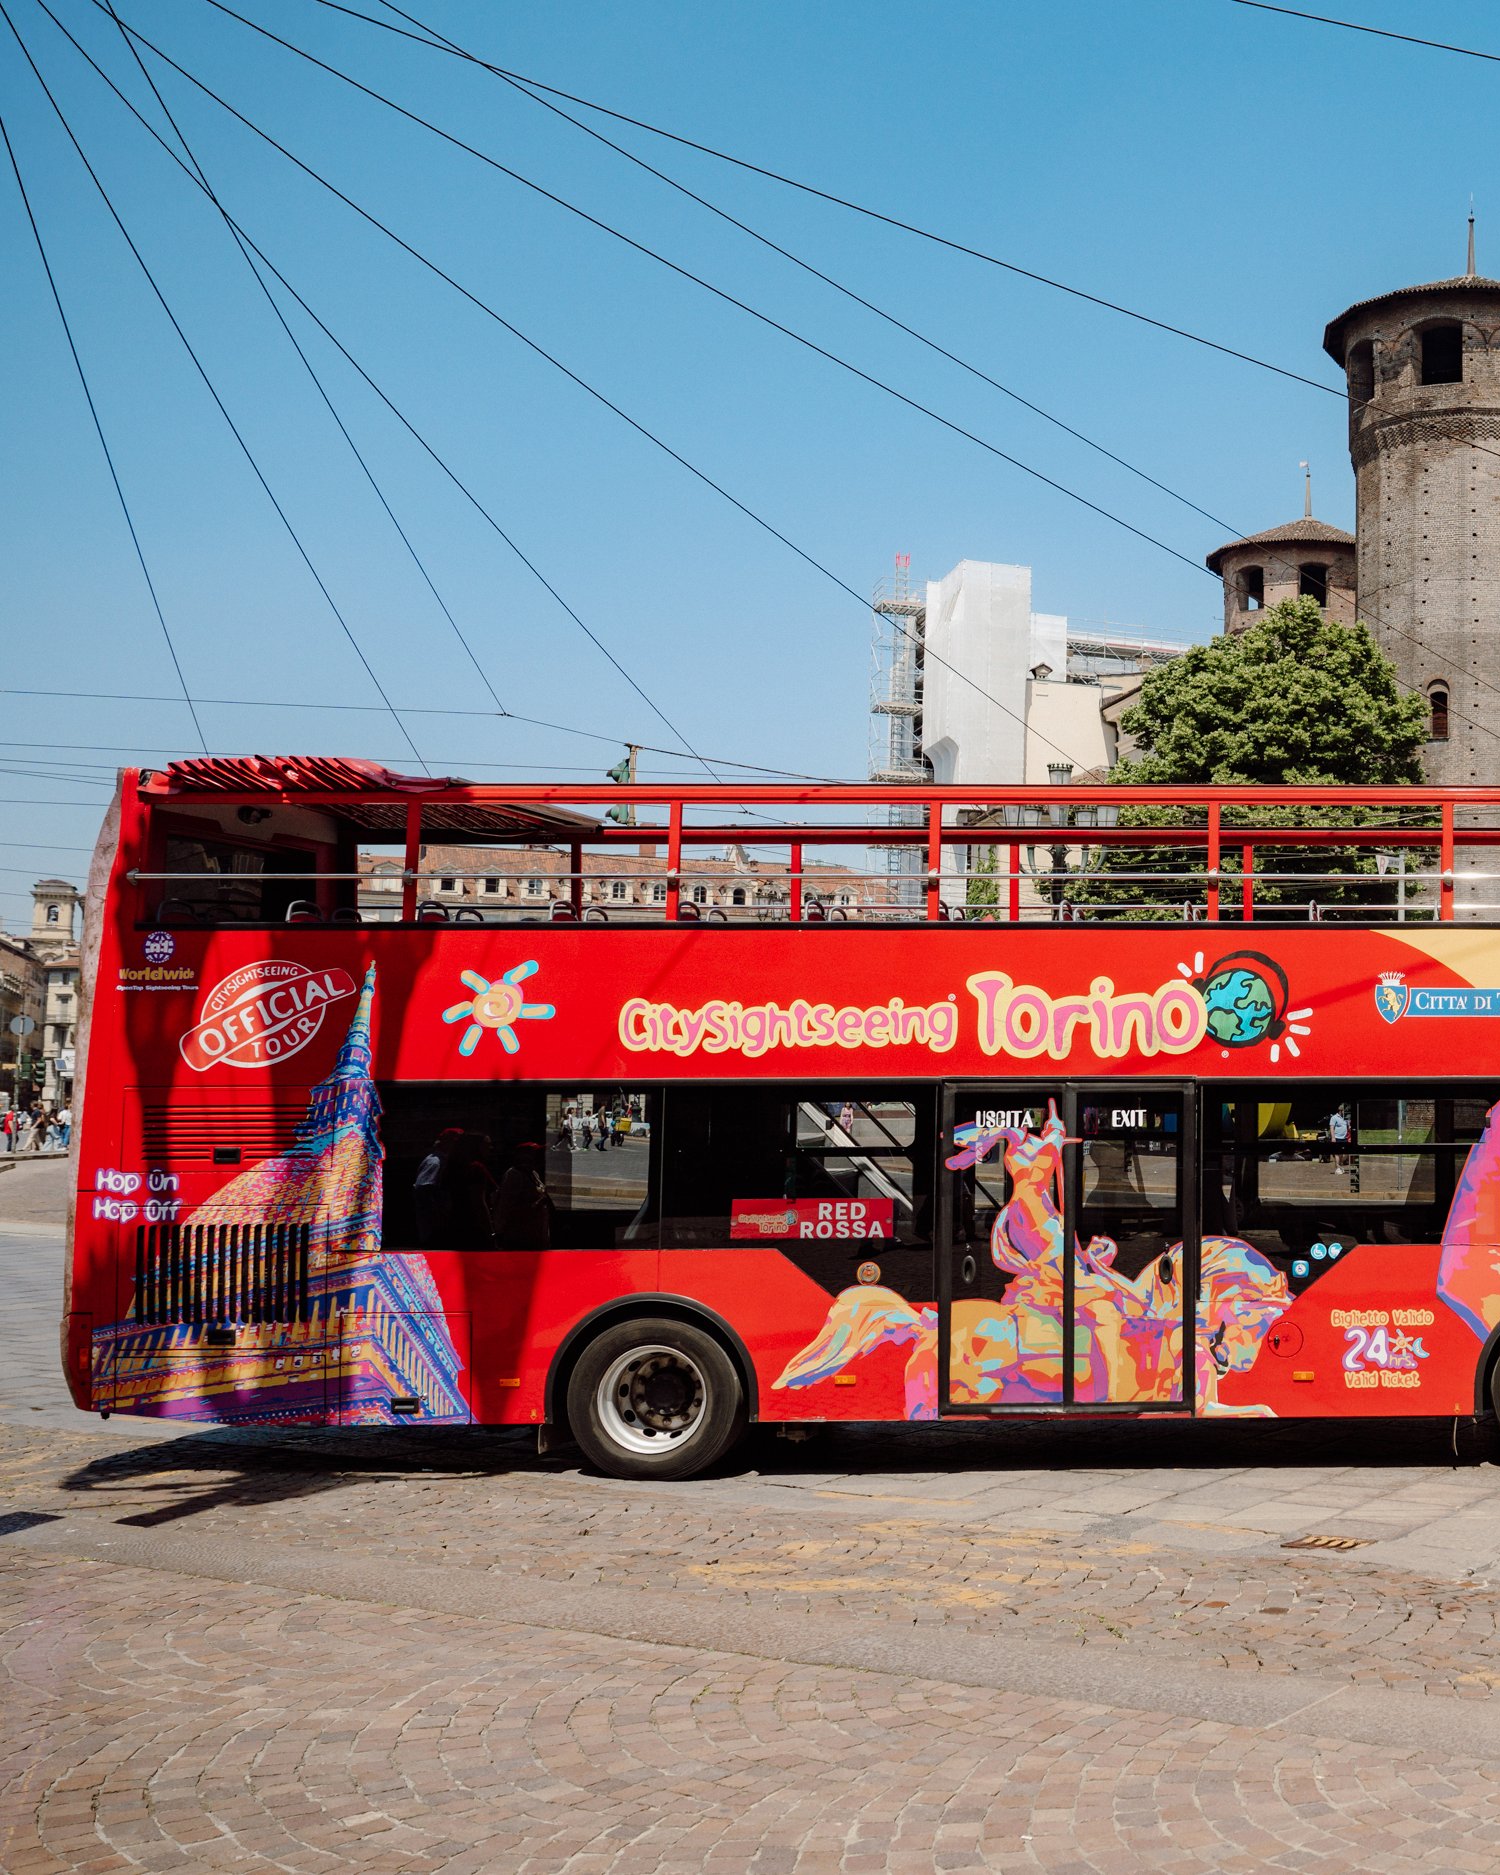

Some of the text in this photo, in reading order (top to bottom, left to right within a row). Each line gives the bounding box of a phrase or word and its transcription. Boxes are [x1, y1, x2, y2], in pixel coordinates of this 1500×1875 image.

[119, 967, 195, 980] Worldwide
[210, 965, 299, 1012] CITYSIGHTSEEING
[198, 974, 346, 1057] OFFICIAL
[618, 971, 1206, 1060] CitySightseeing Torino
[251, 1016, 317, 1059] TOUR
[976, 1110, 1034, 1128] USCITA
[1112, 1109, 1147, 1128] EXIT
[96, 1167, 179, 1196] Hop On
[93, 1196, 183, 1224] Hop Off
[818, 1202, 866, 1220] RED
[759, 1223, 789, 1233] Torino
[800, 1221, 885, 1239] ROSSA
[1331, 1309, 1435, 1329] Biglietto Valido
[1342, 1325, 1388, 1371] 24
[1344, 1369, 1421, 1388] Valid Ticket
